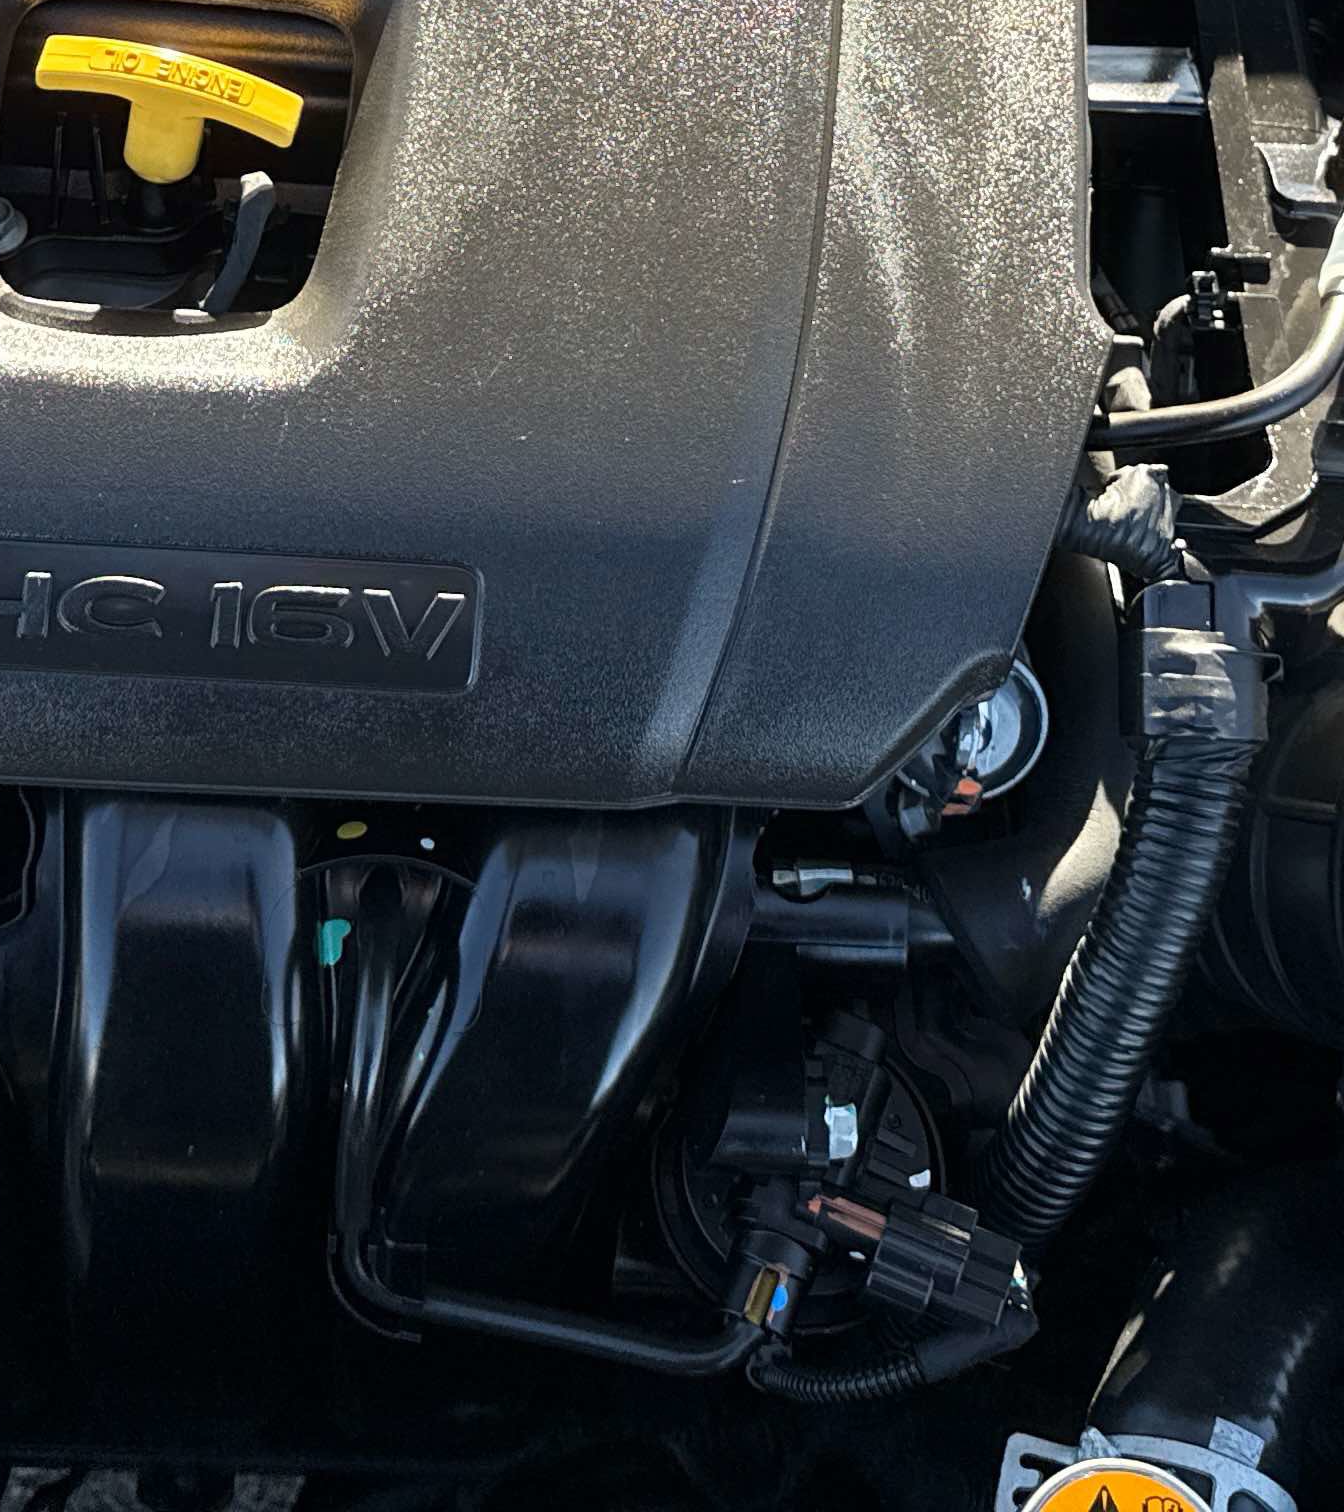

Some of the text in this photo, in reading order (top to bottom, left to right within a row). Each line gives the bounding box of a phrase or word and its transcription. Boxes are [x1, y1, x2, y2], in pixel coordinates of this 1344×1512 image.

[103, 47, 246, 103] ENGINE OIL
[208, 581, 466, 662] 16V
